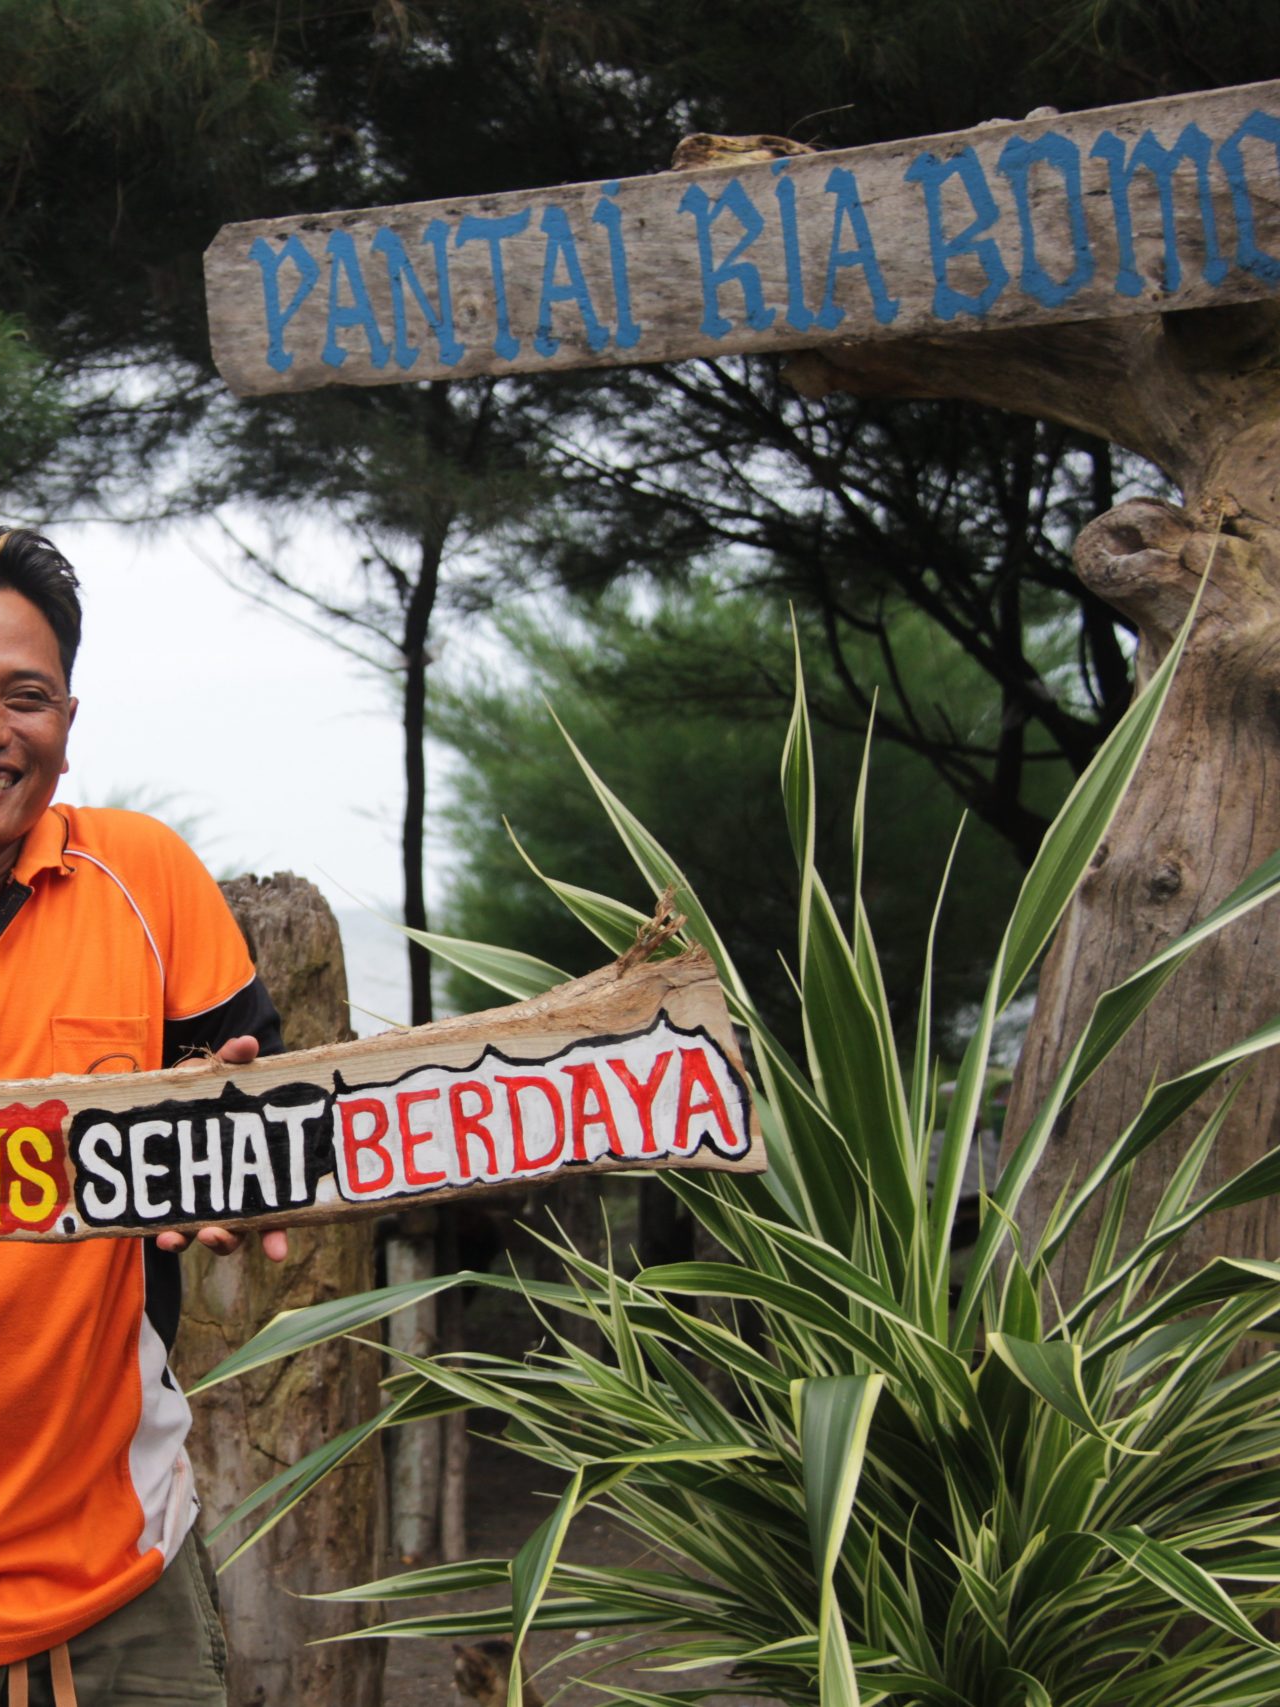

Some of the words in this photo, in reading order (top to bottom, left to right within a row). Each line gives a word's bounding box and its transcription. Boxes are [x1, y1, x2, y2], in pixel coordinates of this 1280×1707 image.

[248, 180, 642, 373] PANTAI
[677, 159, 900, 340] RIA
[78, 1101, 326, 1219] SEHAT
[340, 1047, 738, 1194] BERDAYA
